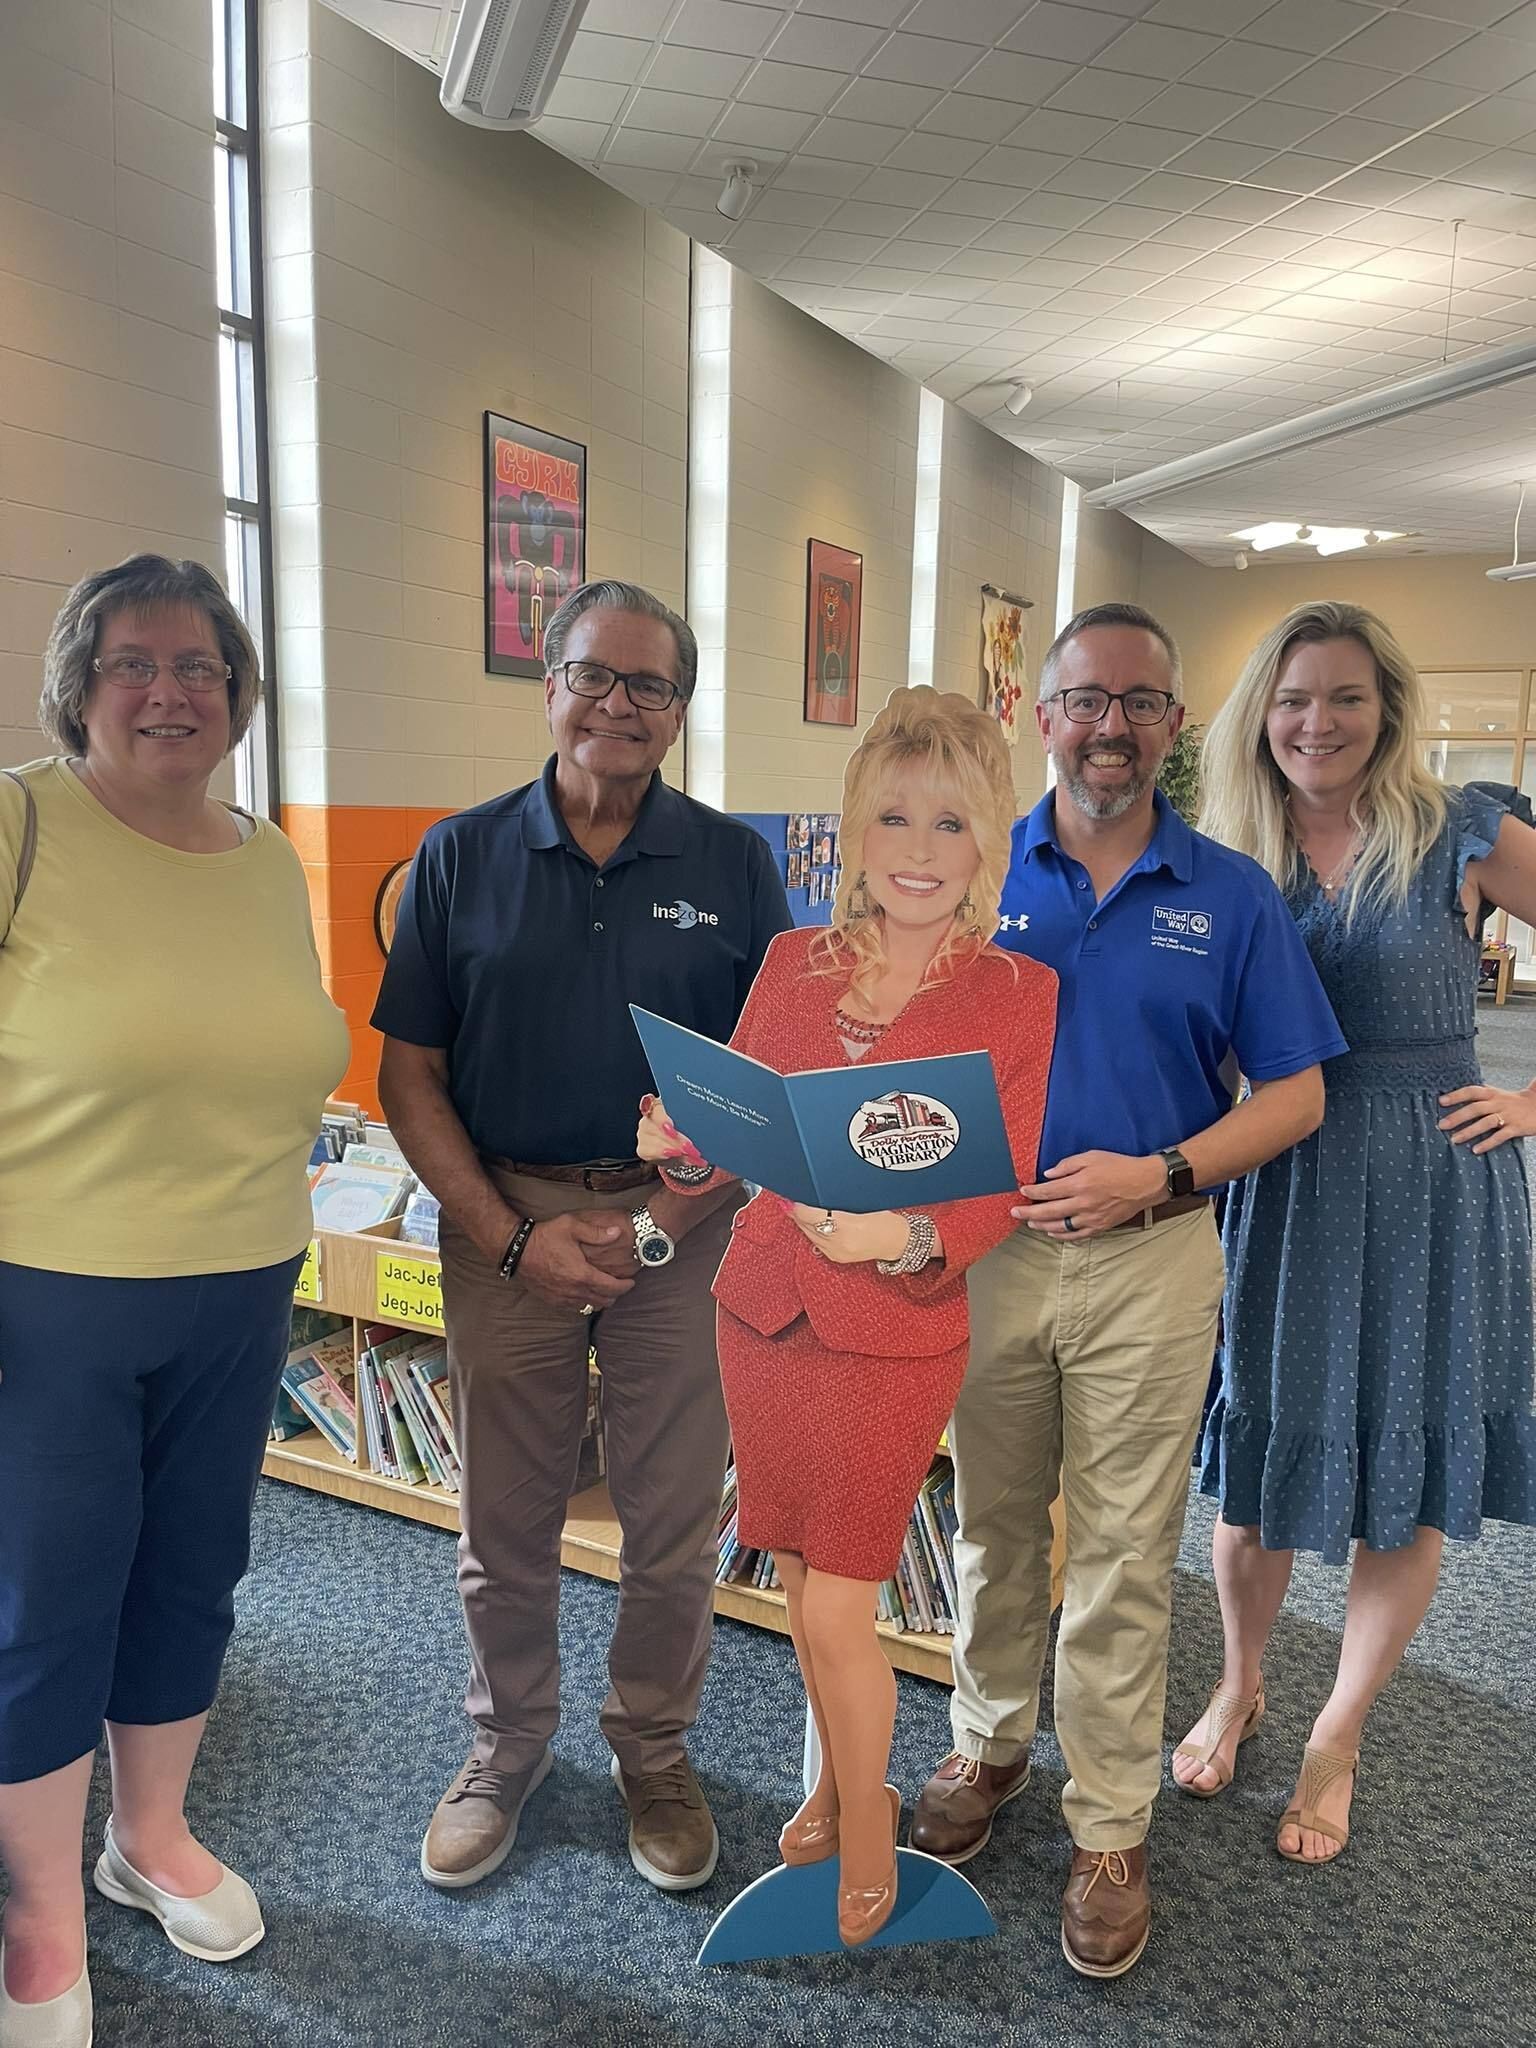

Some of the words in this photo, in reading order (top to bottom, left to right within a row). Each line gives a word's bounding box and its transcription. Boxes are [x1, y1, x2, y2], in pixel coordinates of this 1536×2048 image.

[495, 436, 579, 504] CYRK
[653, 901, 719, 926] inszone
[1156, 909, 1187, 921] United
[1167, 919, 1186, 932] Way
[676, 1074, 703, 1091] Dream
[703, 1087, 727, 1104] More,
[726, 1098, 748, 1113] Learn
[687, 1087, 706, 1101] Care
[706, 1096, 729, 1113] More,
[729, 1107, 740, 1117] Be
[859, 1135, 956, 1159] IMAGINATION
[871, 1138, 898, 1149] Dolly
[880, 1149, 942, 1169] LIBRARY
